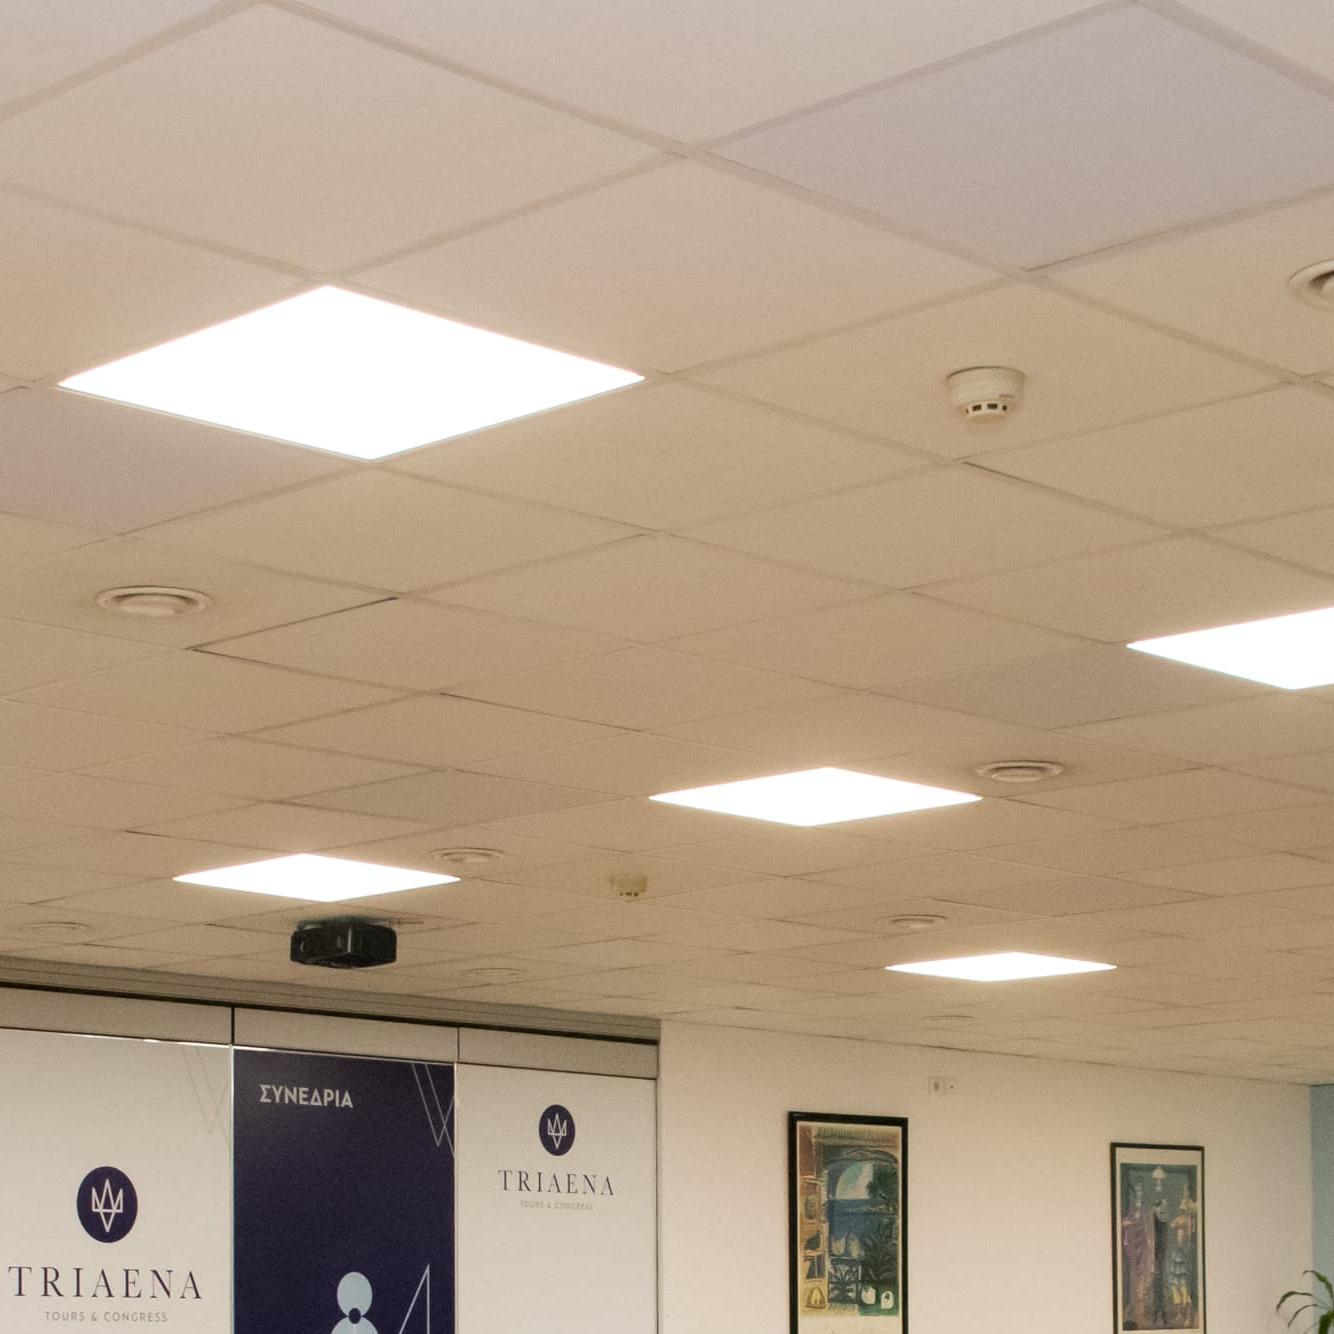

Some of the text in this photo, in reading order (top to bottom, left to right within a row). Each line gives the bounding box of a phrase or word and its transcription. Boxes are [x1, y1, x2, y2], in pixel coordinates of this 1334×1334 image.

[259, 1084, 353, 1108] ΣΥΝΕΔΡΙΑ
[498, 1169, 613, 1195] TRIAENA
[8, 1266, 202, 1299] TRIAENA
[44, 1311, 168, 1322] TOURS & CONGRESS
